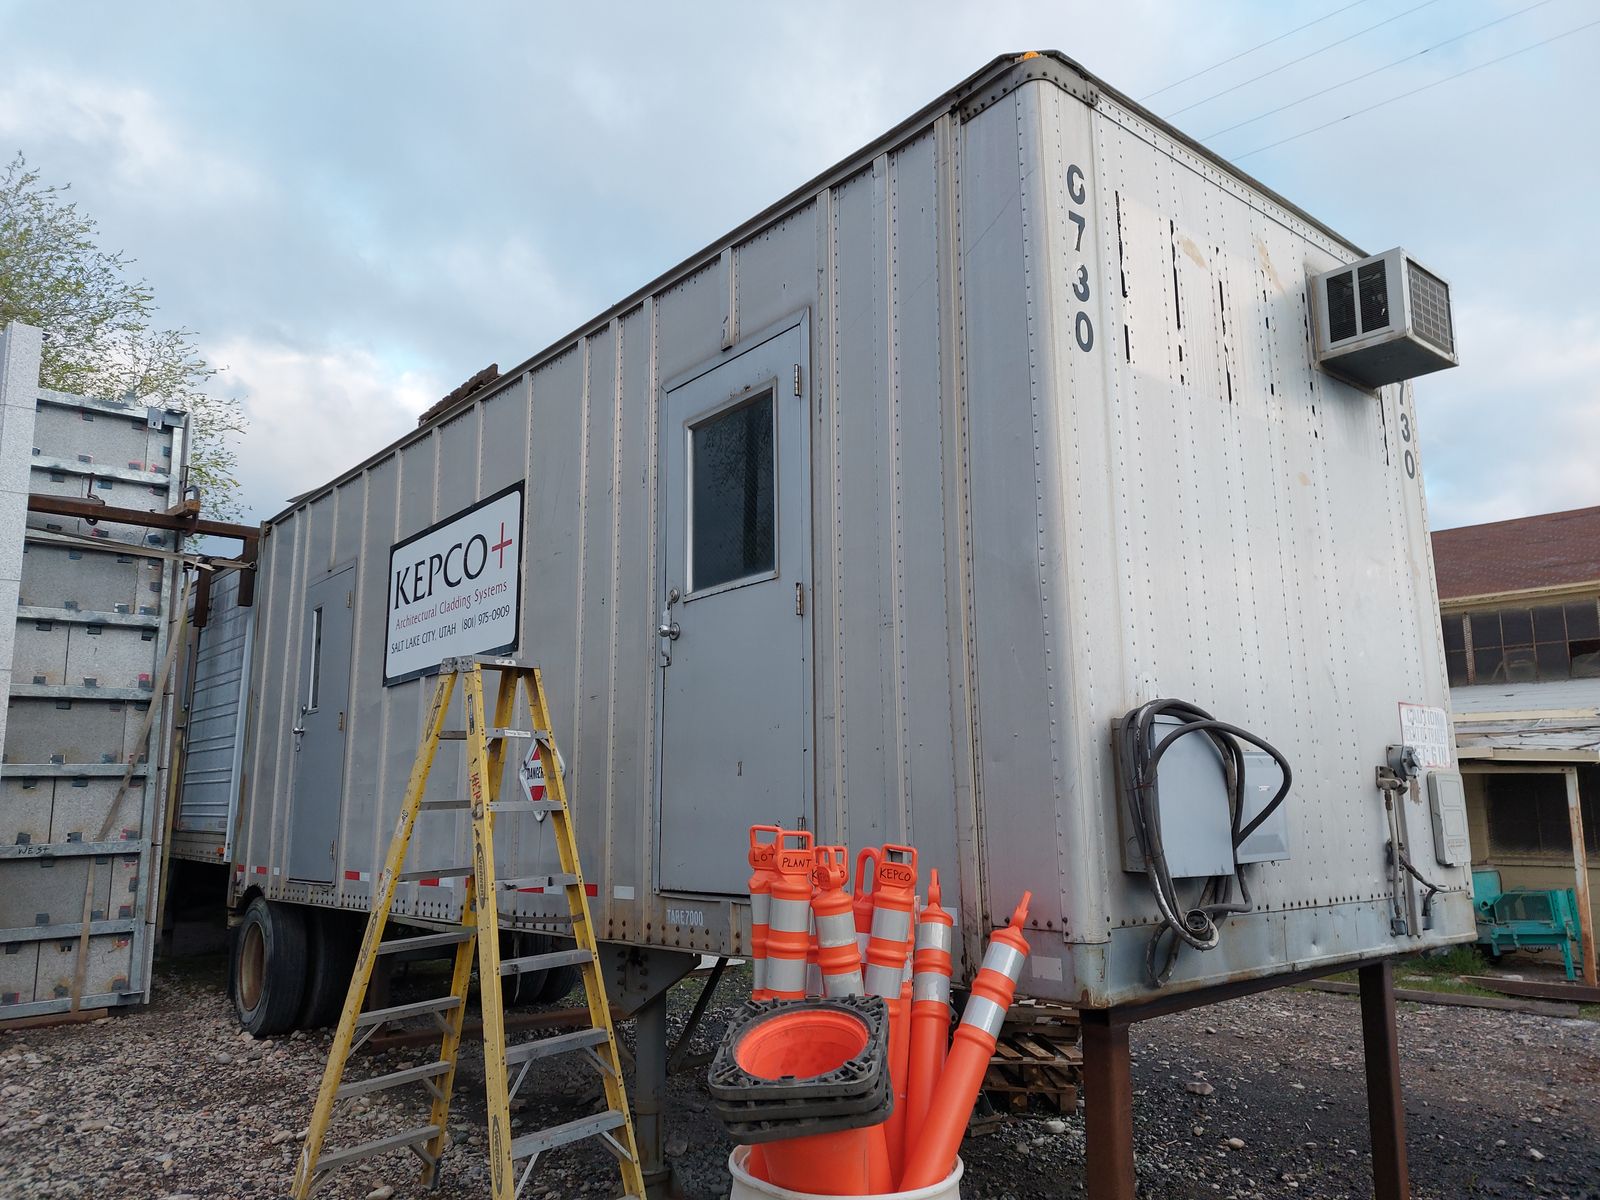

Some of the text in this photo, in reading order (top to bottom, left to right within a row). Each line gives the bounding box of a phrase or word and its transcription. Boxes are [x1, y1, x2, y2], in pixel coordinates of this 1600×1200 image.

[1066, 163, 1094, 353] C730
[395, 580, 508, 631] Architectural Cladding Systems
[391, 640, 405, 654] SALT
[405, 634, 420, 650] LAKE
[438, 622, 457, 639] UTAH
[461, 615, 477, 632] (801)
[478, 604, 510, 626] 975-0909
[753, 853, 775, 862] LOT
[782, 857, 812, 868] PLANT
[880, 868, 911, 881] KEPCO
